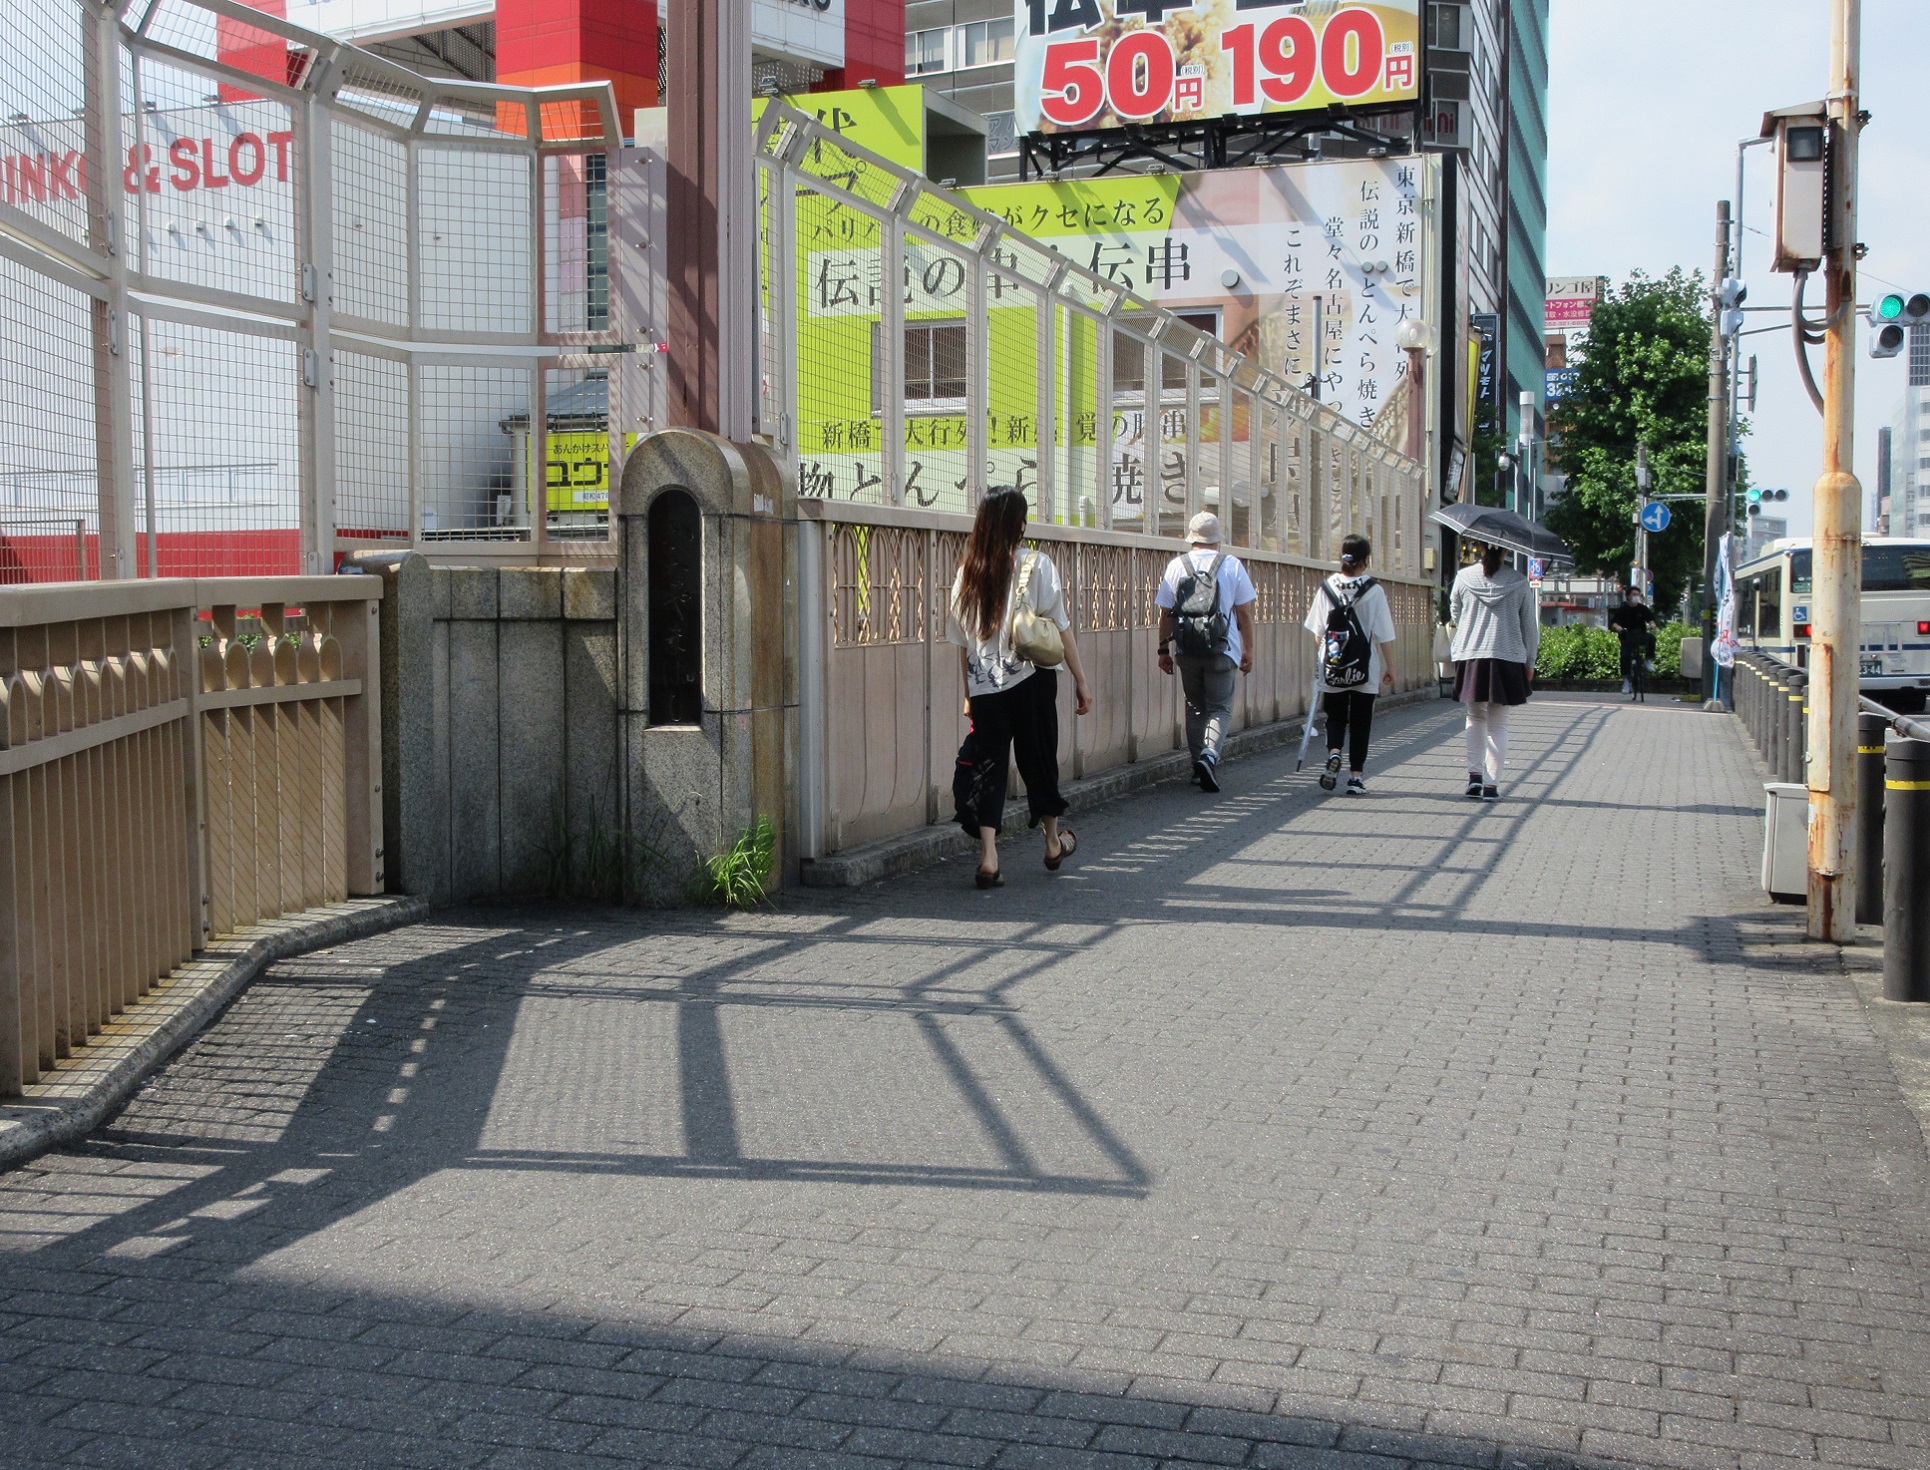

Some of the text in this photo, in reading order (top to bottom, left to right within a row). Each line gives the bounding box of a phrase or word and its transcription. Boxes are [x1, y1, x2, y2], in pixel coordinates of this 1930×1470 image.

[0, 131, 292, 204] INK & SLOT
[1394, 165, 1416, 382] 東京新橋で大列
